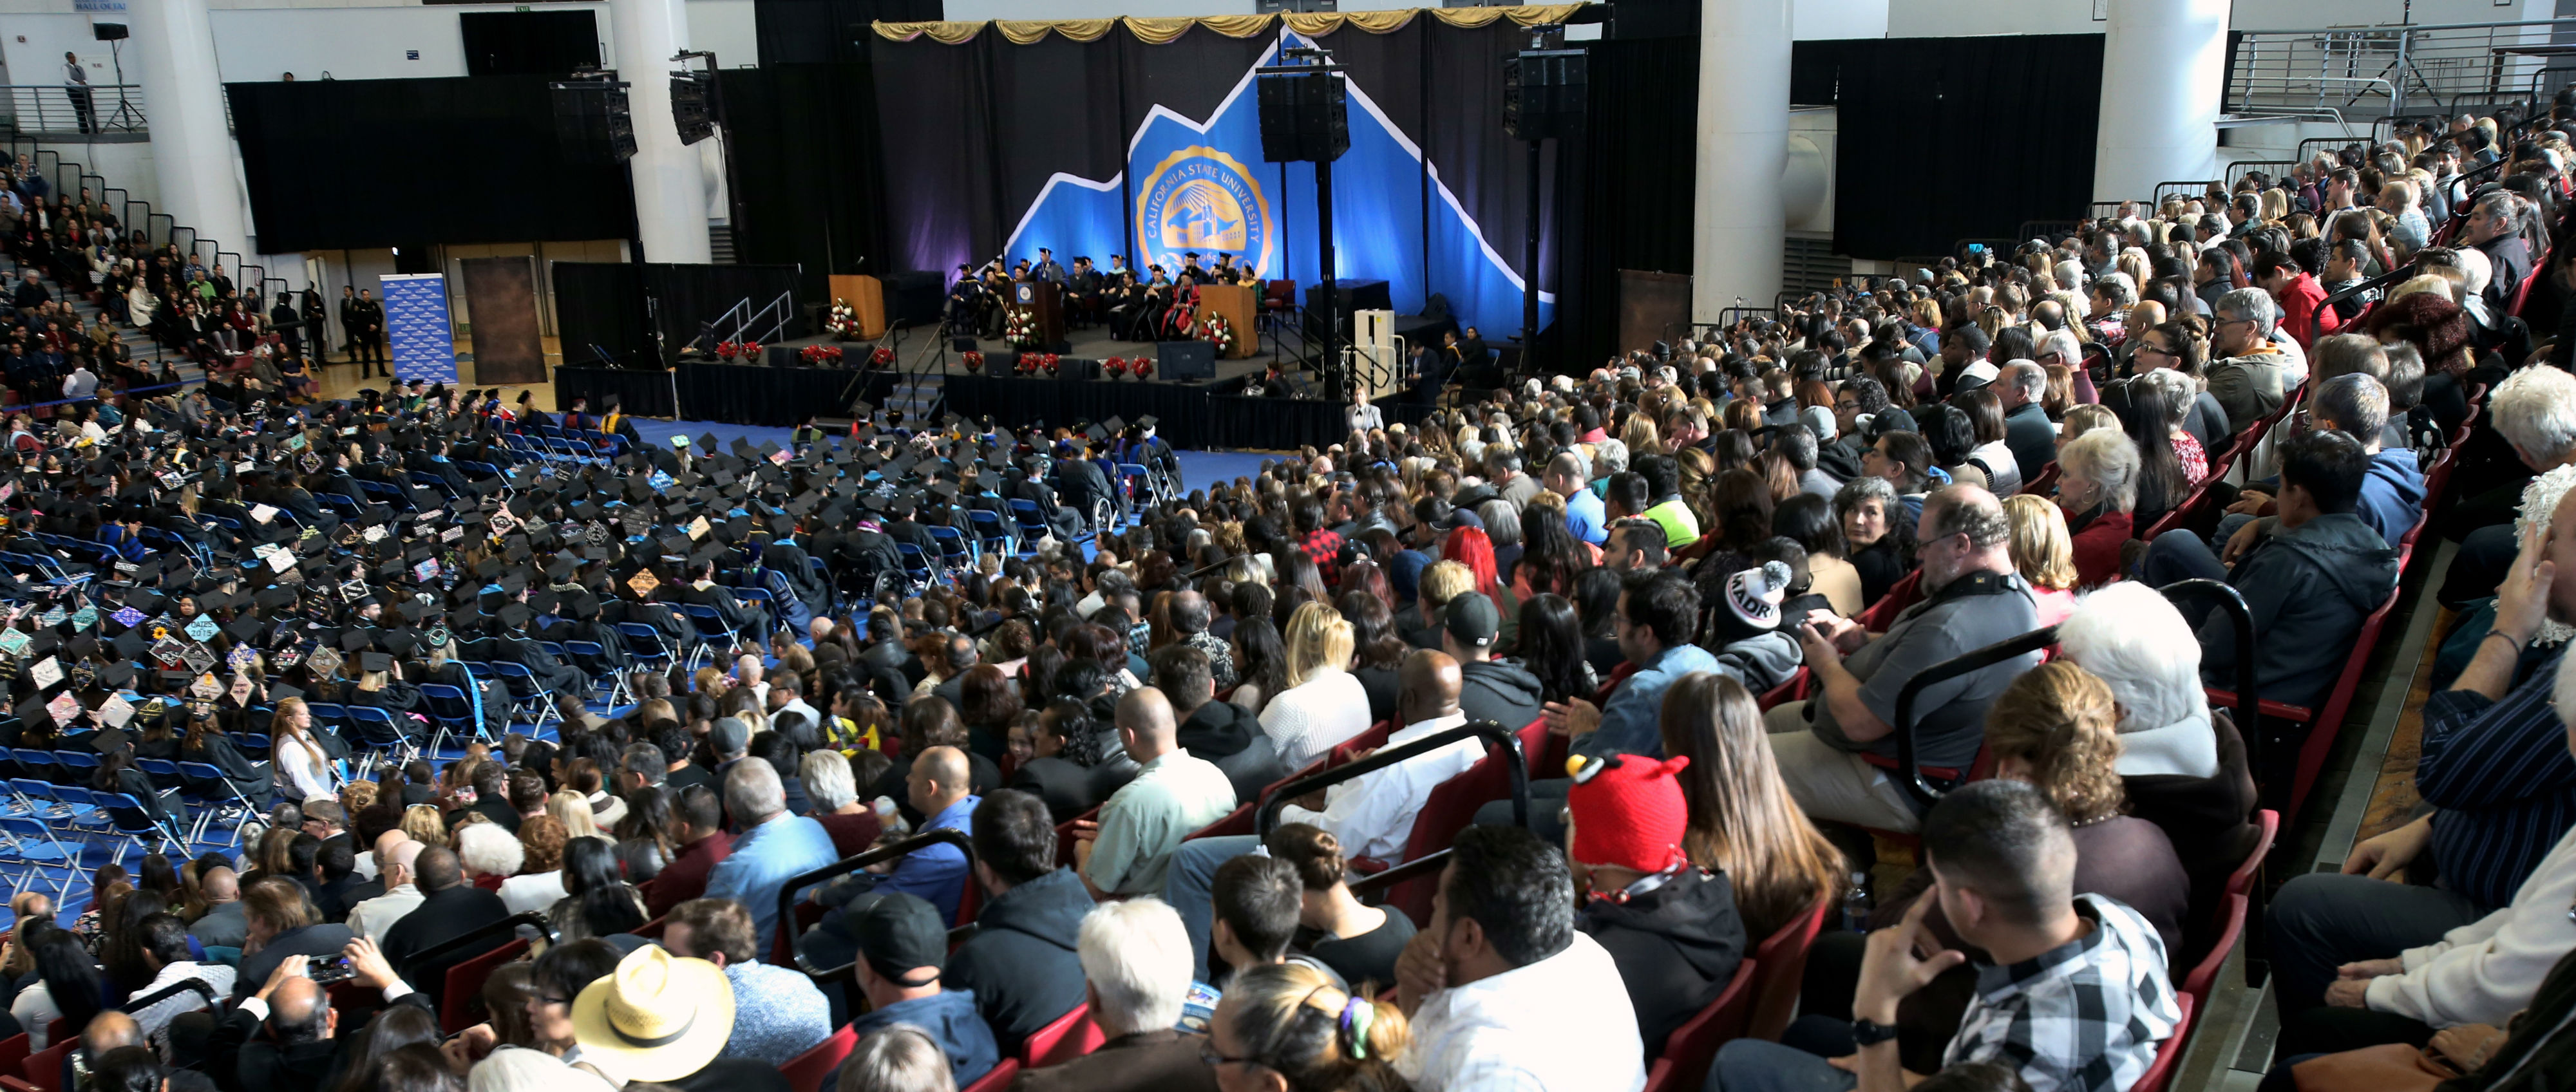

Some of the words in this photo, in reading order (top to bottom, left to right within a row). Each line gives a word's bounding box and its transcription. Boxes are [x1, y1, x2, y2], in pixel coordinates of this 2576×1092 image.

[1148, 169, 1187, 239] CALIFORNIA
[1188, 164, 1218, 178] STATE
[1220, 172, 1260, 243] UNIVERSITY
[1731, 574, 1777, 618] MADRI
